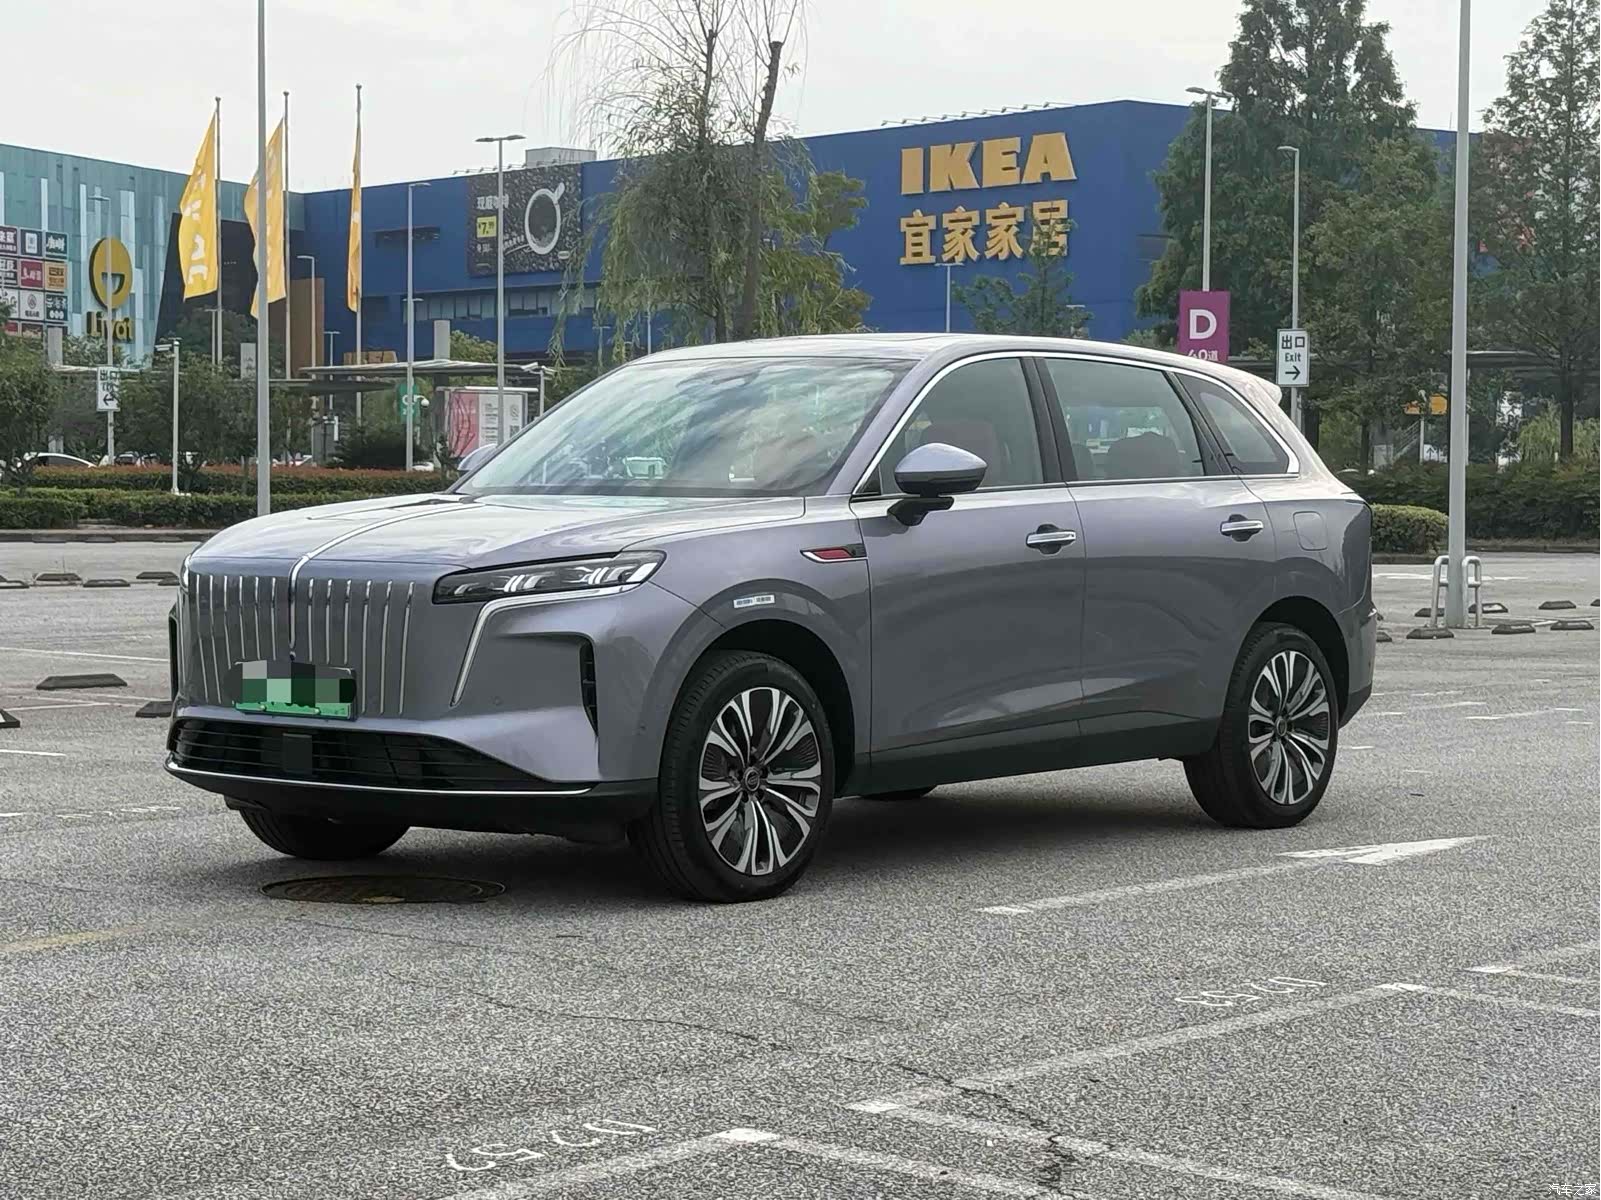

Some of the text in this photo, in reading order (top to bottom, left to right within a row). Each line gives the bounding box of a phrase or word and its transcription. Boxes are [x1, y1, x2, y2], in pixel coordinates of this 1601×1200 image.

[901, 132, 1078, 195] IKEA
[900, 199, 1069, 265] 宜家家居
[1189, 309, 1218, 340] D
[1281, 335, 1306, 349] 出口
[1285, 353, 1301, 362] Exit
